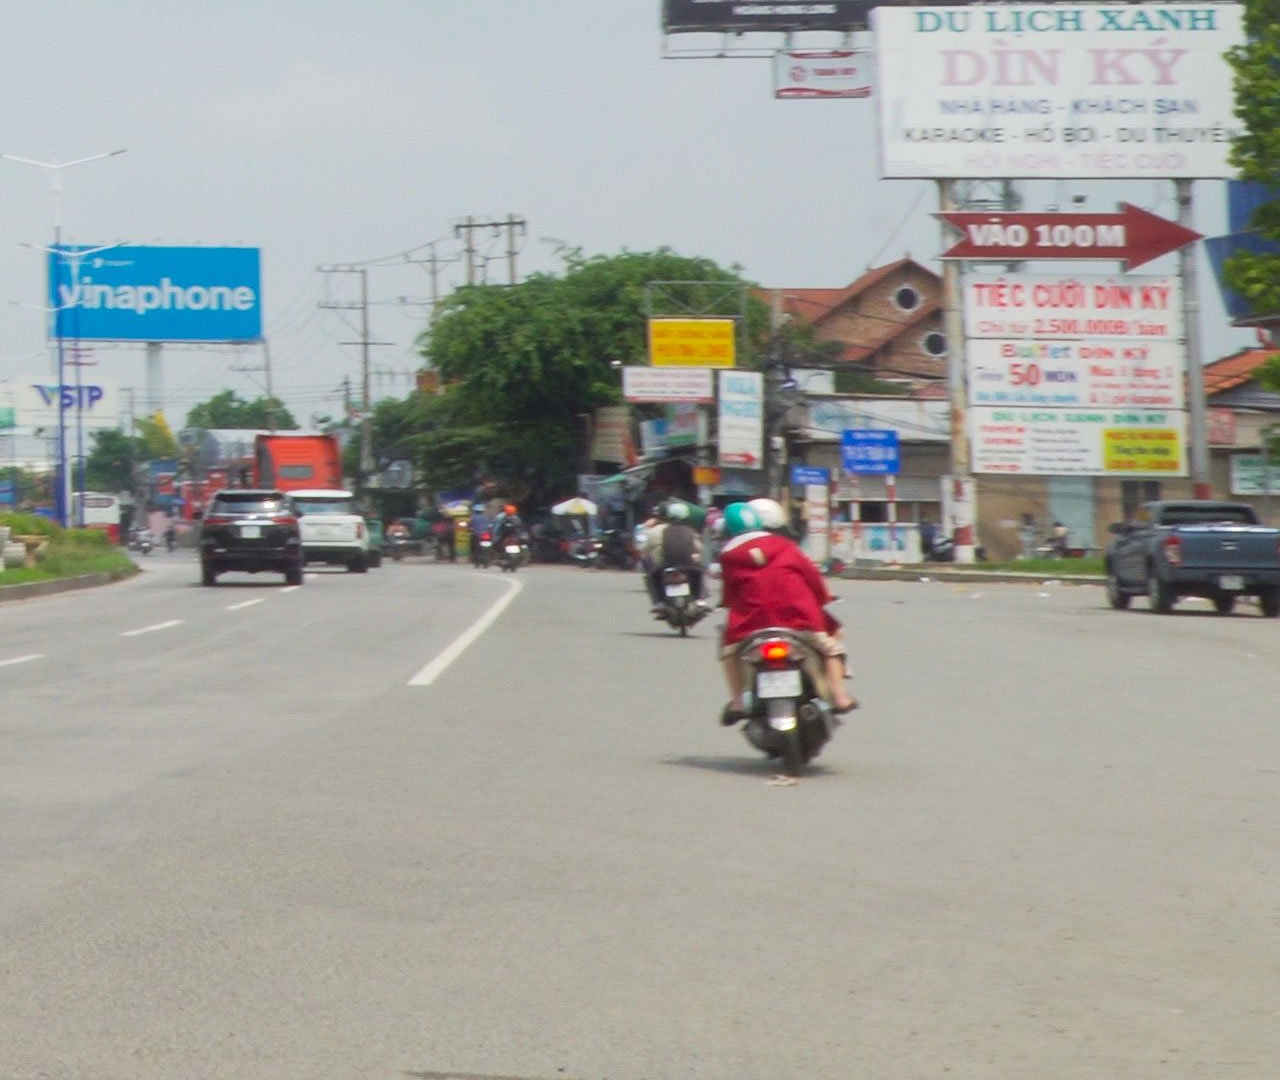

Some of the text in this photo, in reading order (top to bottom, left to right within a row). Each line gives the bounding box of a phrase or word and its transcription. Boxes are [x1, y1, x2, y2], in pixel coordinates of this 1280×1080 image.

[914, 9, 1219, 39] DU LỊCH XANH
[938, 35, 1189, 87] DÌN KÝ
[903, 127, 1006, 143] KARAOKE
[967, 217, 1127, 248] VÀO 100M
[58, 275, 257, 315] vinaphone
[1008, 362, 1041, 387] 50
